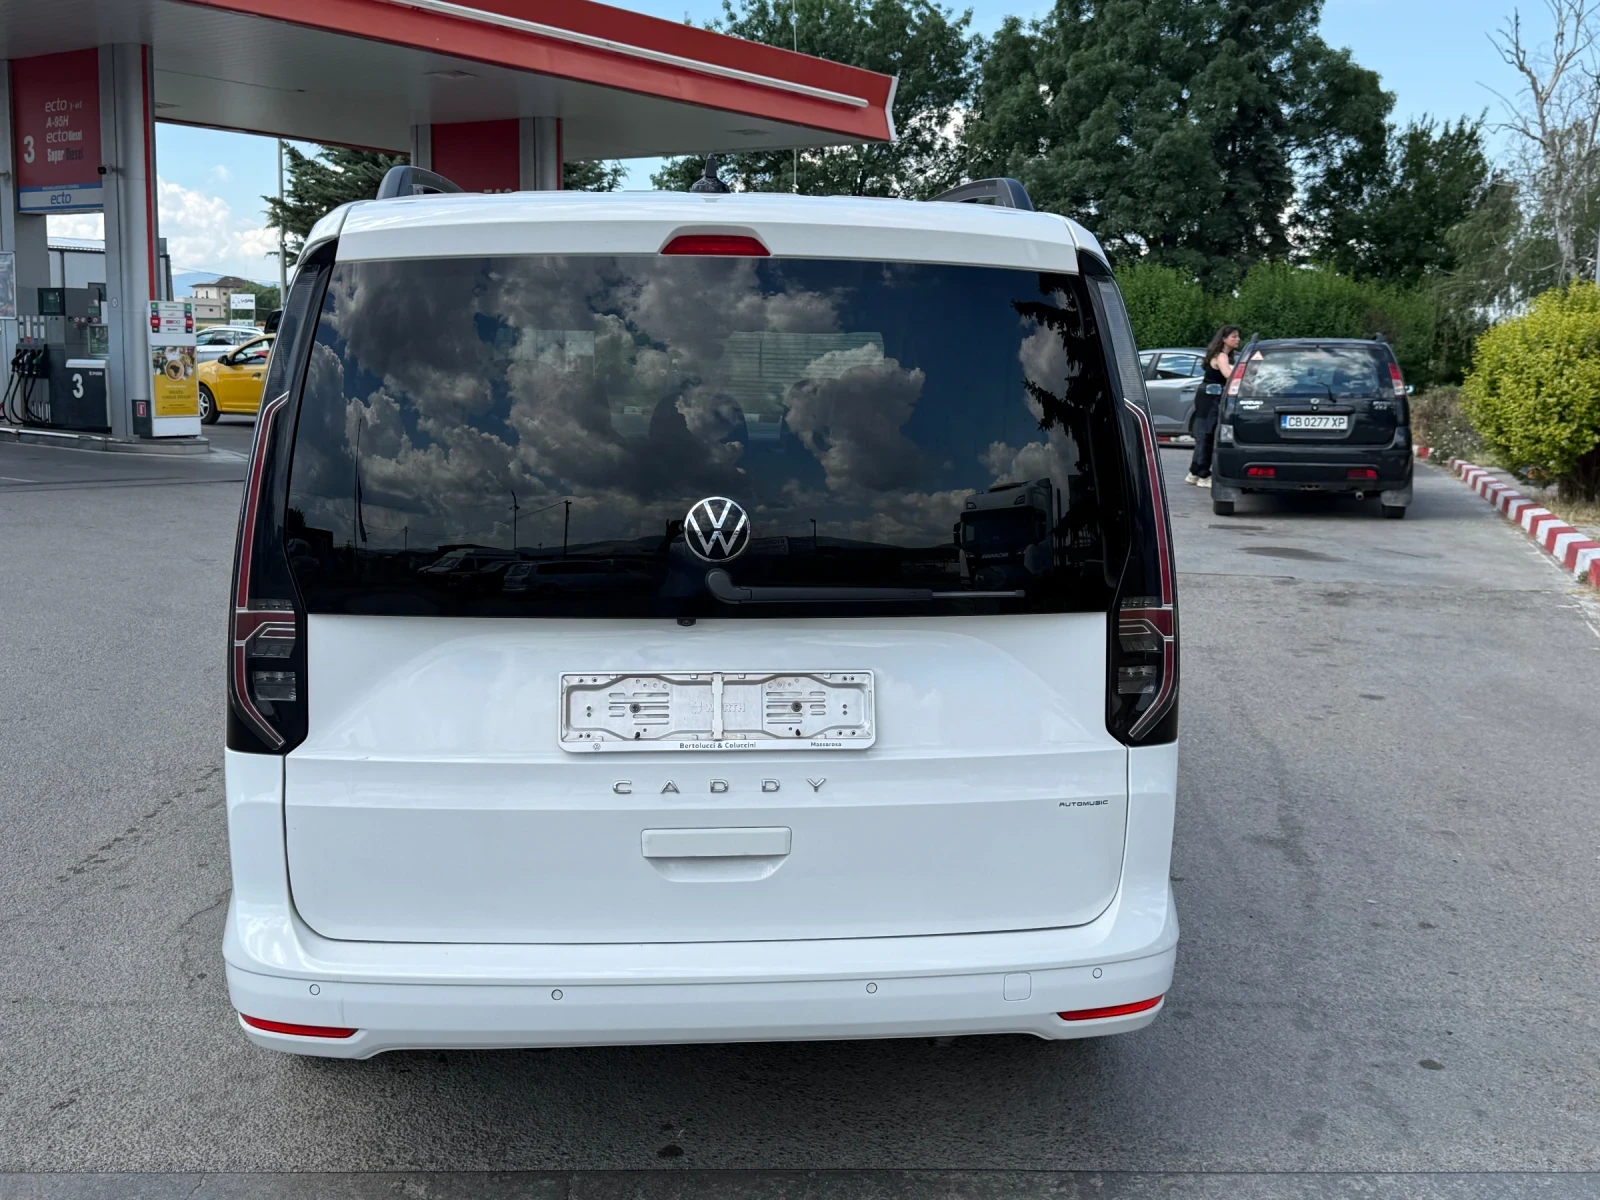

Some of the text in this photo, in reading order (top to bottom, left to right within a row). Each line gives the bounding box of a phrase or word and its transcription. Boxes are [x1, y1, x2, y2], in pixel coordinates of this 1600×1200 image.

[45, 98, 67, 112] ecto
[23, 135, 35, 163] 3
[50, 191, 72, 204] ecto
[72, 373, 84, 399] 3
[1288, 417, 1346, 428] CB 0277 XP
[704, 702, 746, 713] WRTH
[679, 742, 716, 750] Bertolucci
[724, 741, 757, 749] Coluccini
[612, 778, 827, 794] CADDY
[1059, 799, 1109, 807] AUTOMUSIC
